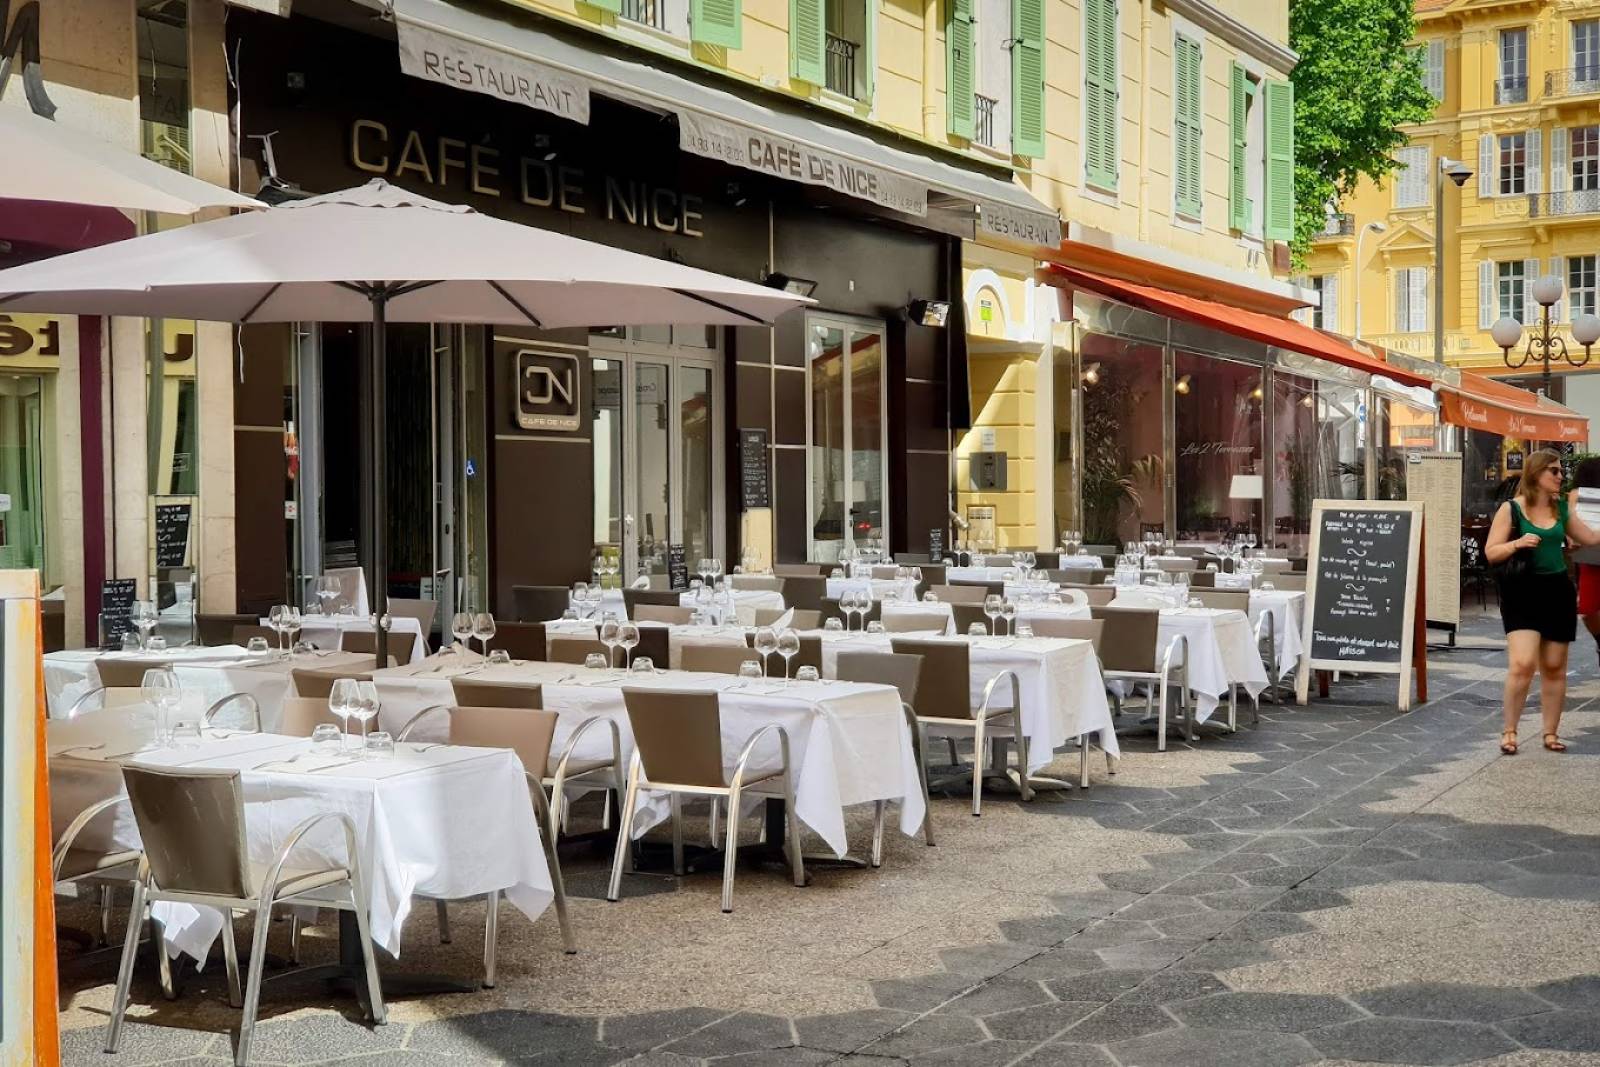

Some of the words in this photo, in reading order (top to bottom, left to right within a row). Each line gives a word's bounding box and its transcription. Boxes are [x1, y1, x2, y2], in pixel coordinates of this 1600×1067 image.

[424, 51, 572, 113] RESTAURANT
[353, 119, 501, 197] CAFÉ
[521, 157, 586, 214] DE
[605, 175, 704, 238] NICE
[749, 138, 802, 178] CAFÉ
[807, 155, 835, 185] DE
[838, 164, 878, 199] NICE
[987, 213, 1053, 244] RESTAURANT
